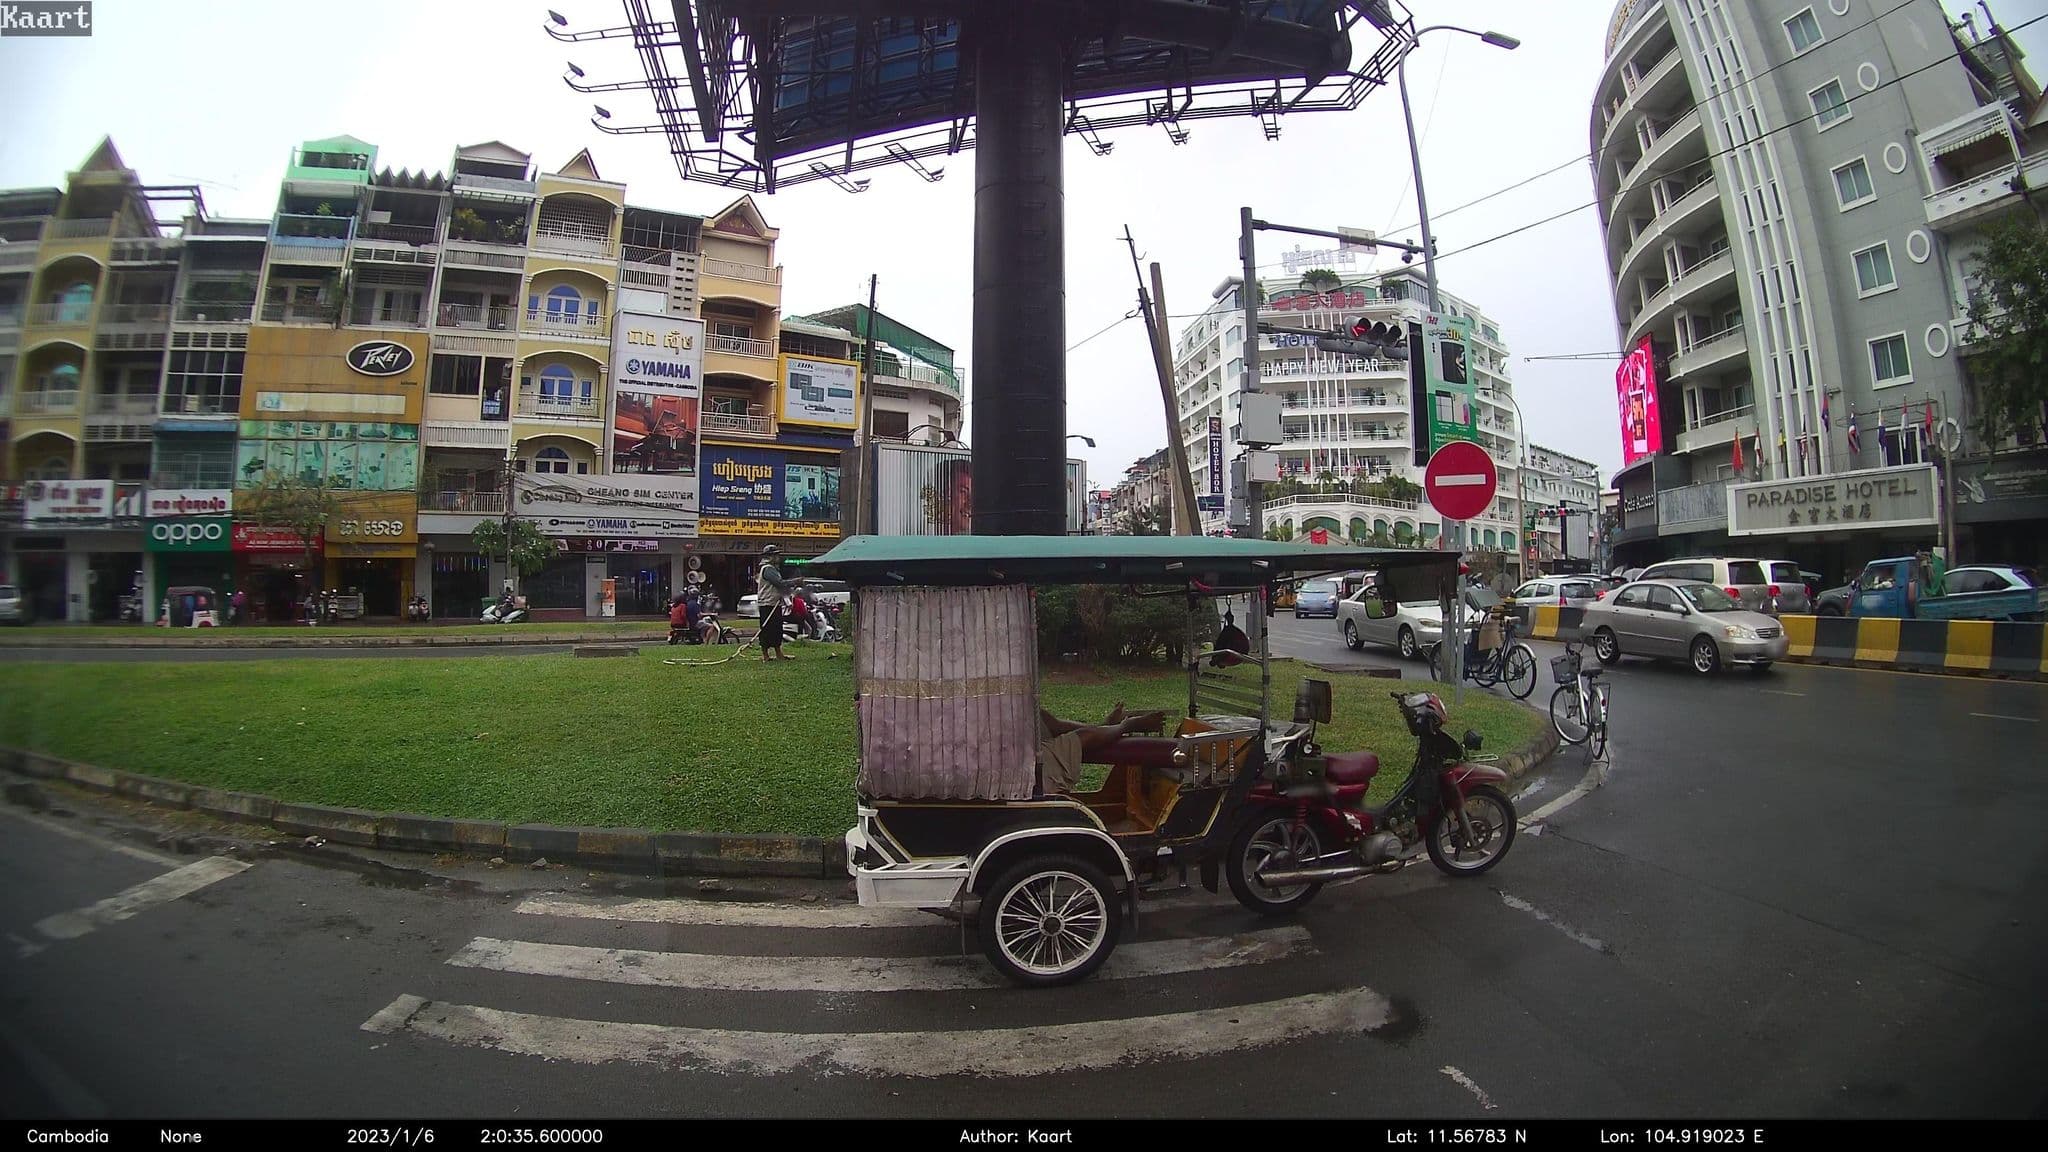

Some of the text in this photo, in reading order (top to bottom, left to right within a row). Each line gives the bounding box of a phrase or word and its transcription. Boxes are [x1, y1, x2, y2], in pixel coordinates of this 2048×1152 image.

[360, 345, 404, 370] PEAVEY
[641, 360, 691, 380] YAMAHA
[1266, 358, 1379, 377] HAPPY NEW YEAR
[587, 487, 629, 498] CHEANG
[634, 489, 651, 498] SIM
[655, 490, 695, 501] CENTER
[1747, 478, 1917, 508] PARADISE HOTEL
[596, 518, 628, 529] YAMAHA
